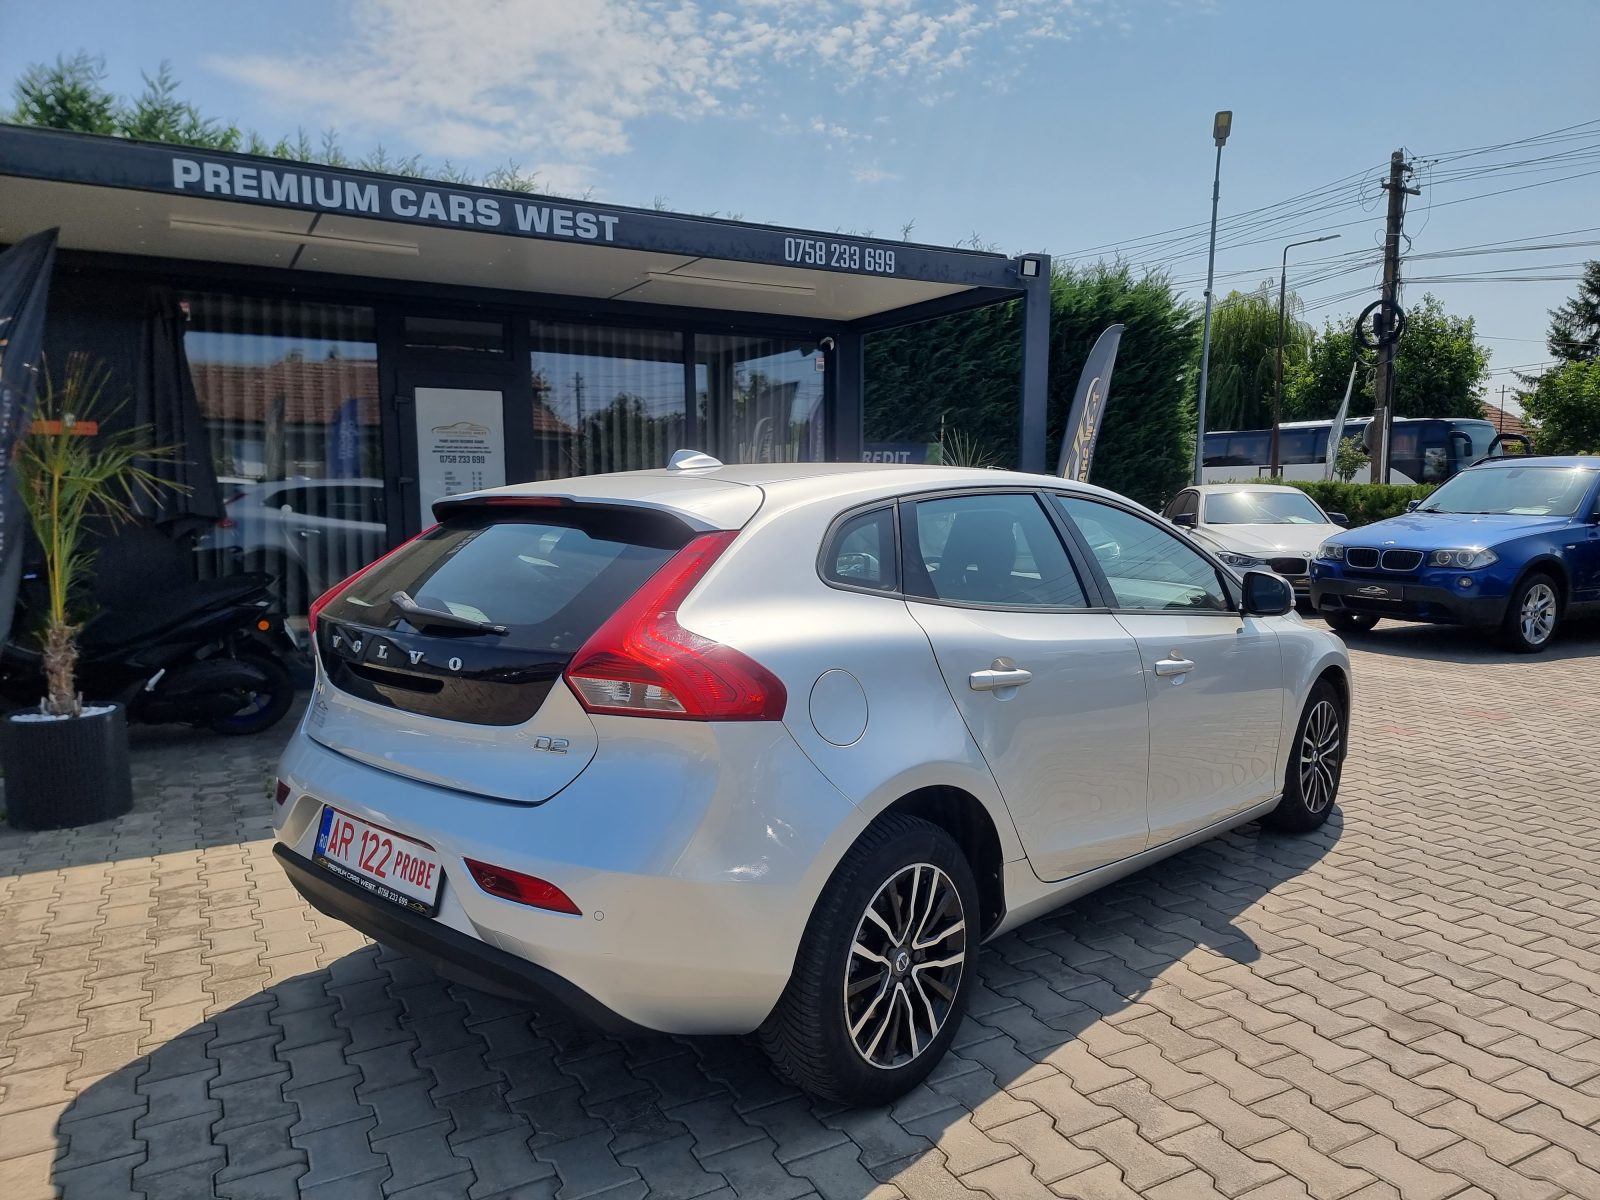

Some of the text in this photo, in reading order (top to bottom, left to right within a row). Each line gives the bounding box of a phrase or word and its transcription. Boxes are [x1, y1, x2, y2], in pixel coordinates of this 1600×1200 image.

[172, 157, 619, 241] PREMIUM CARS WEST
[784, 237, 896, 274] 0758 233 699
[440, 455, 457, 464] 0758
[458, 455, 471, 464] 233
[862, 451, 911, 464] REDIT
[332, 634, 463, 672] VOLVO
[532, 735, 569, 755] D2
[327, 818, 436, 890] AR 122 PROBE
[327, 862, 348, 877] PREMIUM
[346, 871, 360, 884] CARS
[377, 886, 390, 898] 0758
[389, 890, 399, 902] 233
